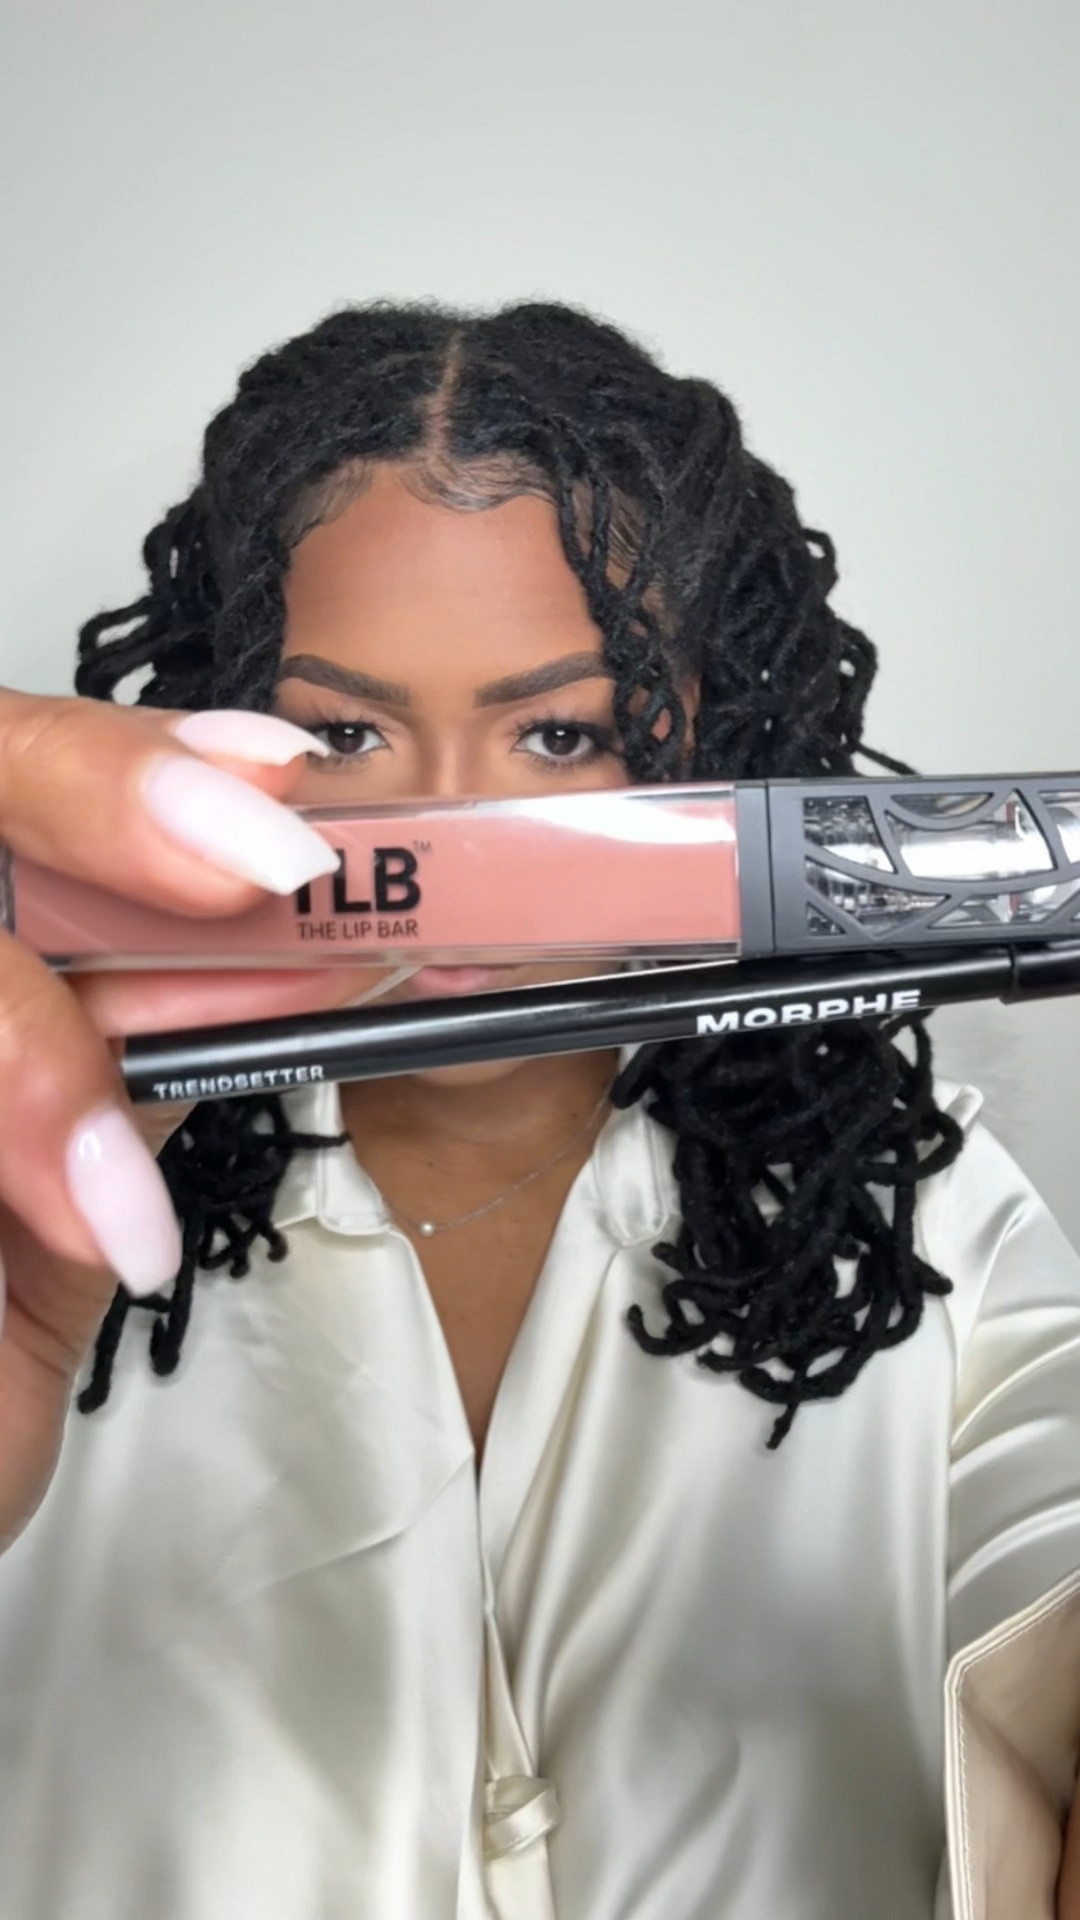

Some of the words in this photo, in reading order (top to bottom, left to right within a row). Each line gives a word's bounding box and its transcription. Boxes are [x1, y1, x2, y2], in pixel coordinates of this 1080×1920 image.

[297, 921, 337, 940] THE
[343, 920, 372, 939] LIP
[377, 919, 418, 938] BAR
[696, 989, 921, 1034] MORPHE
[152, 1065, 325, 1099] TRENDSETTER
